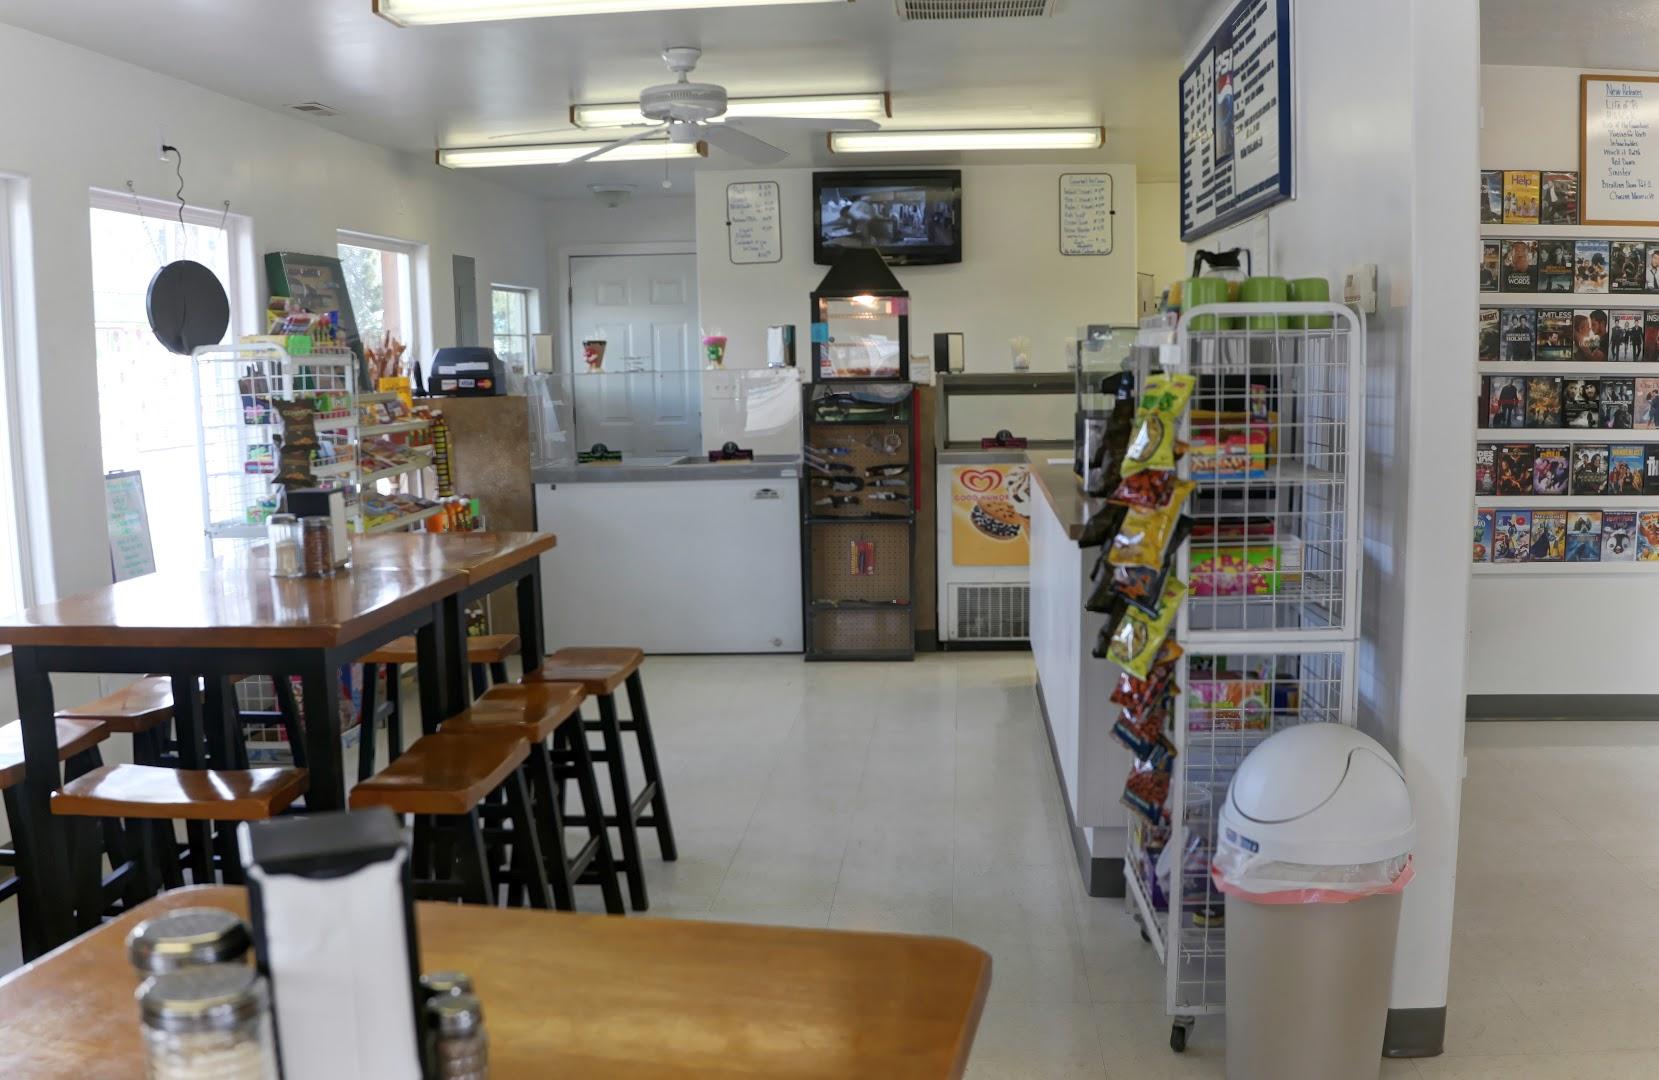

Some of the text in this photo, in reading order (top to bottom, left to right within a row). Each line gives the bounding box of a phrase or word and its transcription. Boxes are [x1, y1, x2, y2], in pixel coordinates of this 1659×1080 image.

[1606, 83, 1621, 96] New
[1611, 157, 1621, 166] Red
[1608, 167, 1632, 177] Sinister
[1512, 174, 1532, 187] Help
[1537, 311, 1572, 320] LIMITLESS
